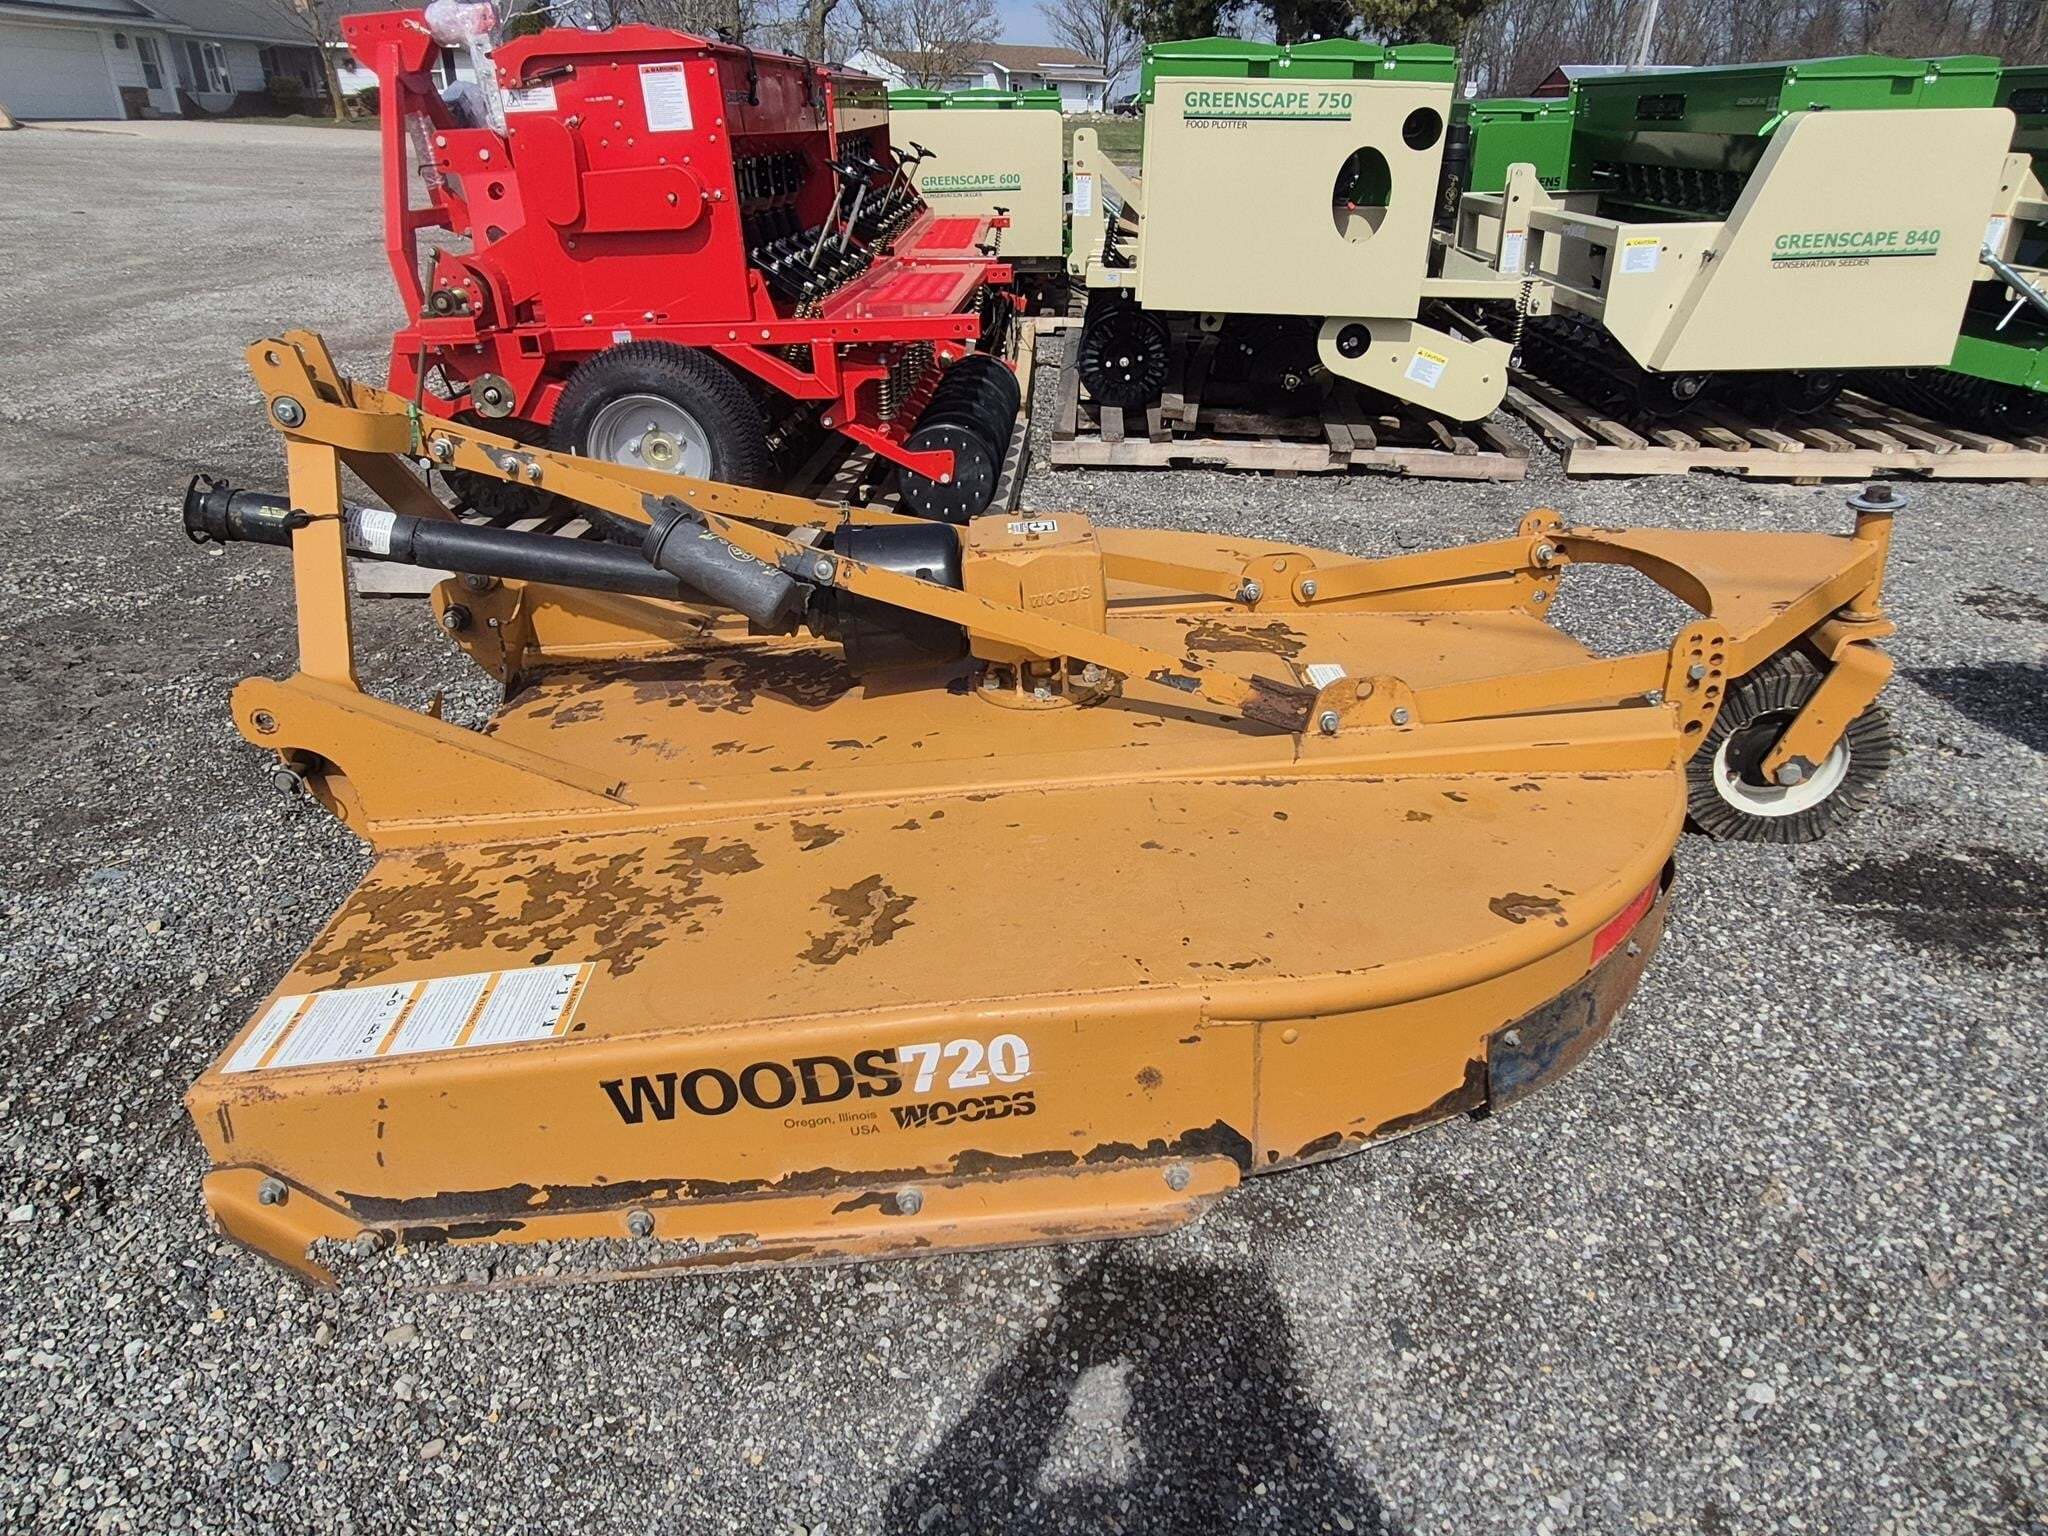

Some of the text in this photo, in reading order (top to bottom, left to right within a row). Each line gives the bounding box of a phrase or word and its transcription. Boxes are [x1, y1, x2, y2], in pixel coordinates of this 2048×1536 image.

[1184, 91, 1353, 109] GREENSCAPE 750
[1185, 120, 1248, 129] FOOD PLOTTER
[921, 173, 1021, 187] GREENSCAPE 600
[1774, 229, 1941, 250] GREENSCAPE 840
[1772, 257, 1870, 270] CONSERVATION SEEDER
[1028, 585, 1092, 609] WOODS
[598, 1033, 1031, 1125] WOODS 720
[889, 1090, 1037, 1131] WOODS
[783, 1111, 878, 1130] Oregon, Illinois
[850, 1123, 881, 1137] USA
